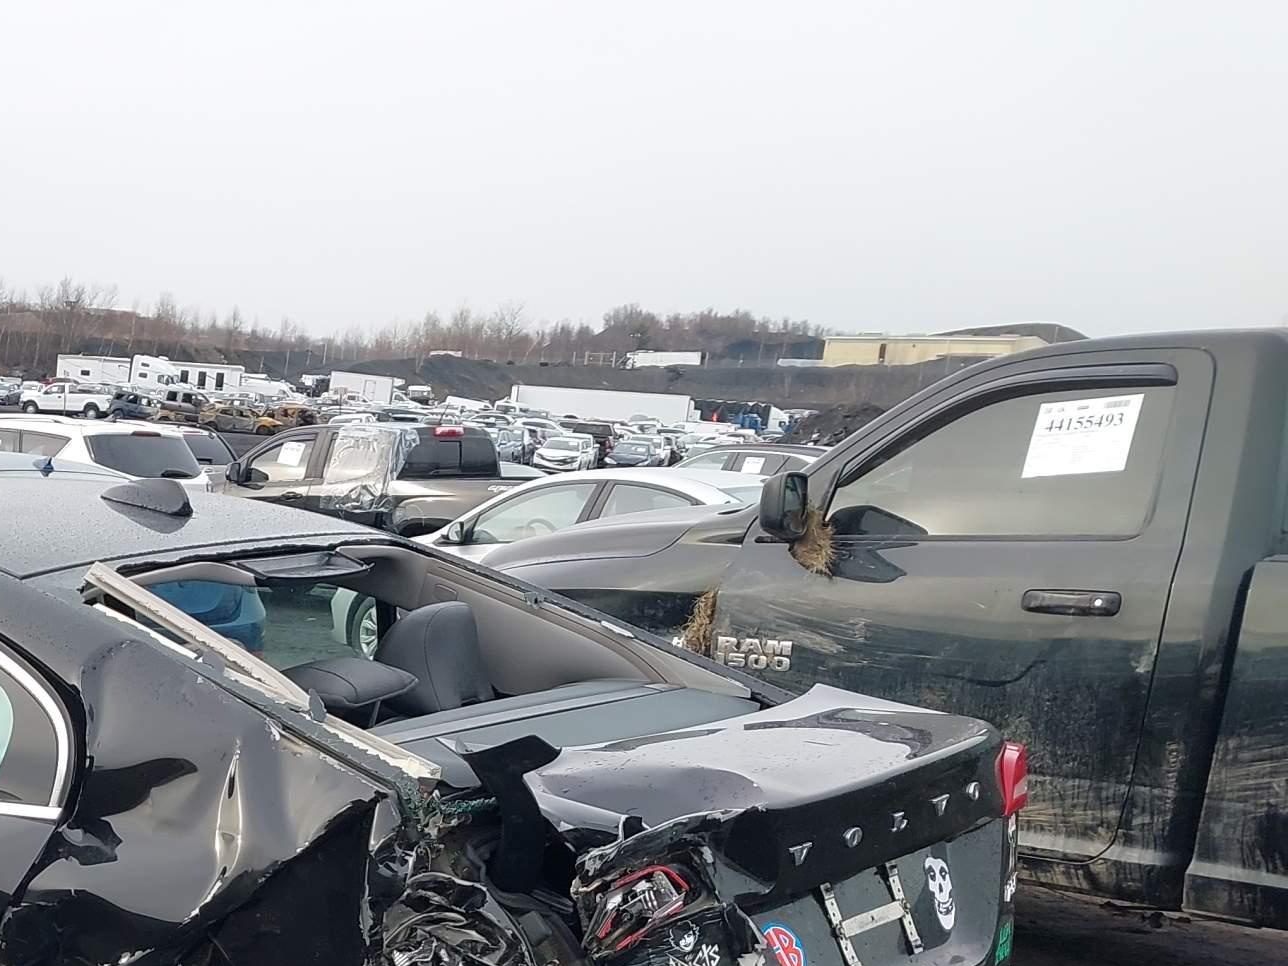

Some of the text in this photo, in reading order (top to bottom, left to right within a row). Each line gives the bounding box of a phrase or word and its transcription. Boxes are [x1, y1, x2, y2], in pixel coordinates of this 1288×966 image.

[1044, 412, 1124, 432] 44155493
[717, 636, 793, 656] RAM
[715, 652, 791, 672] 1500
[788, 781, 982, 867] VOLVO
